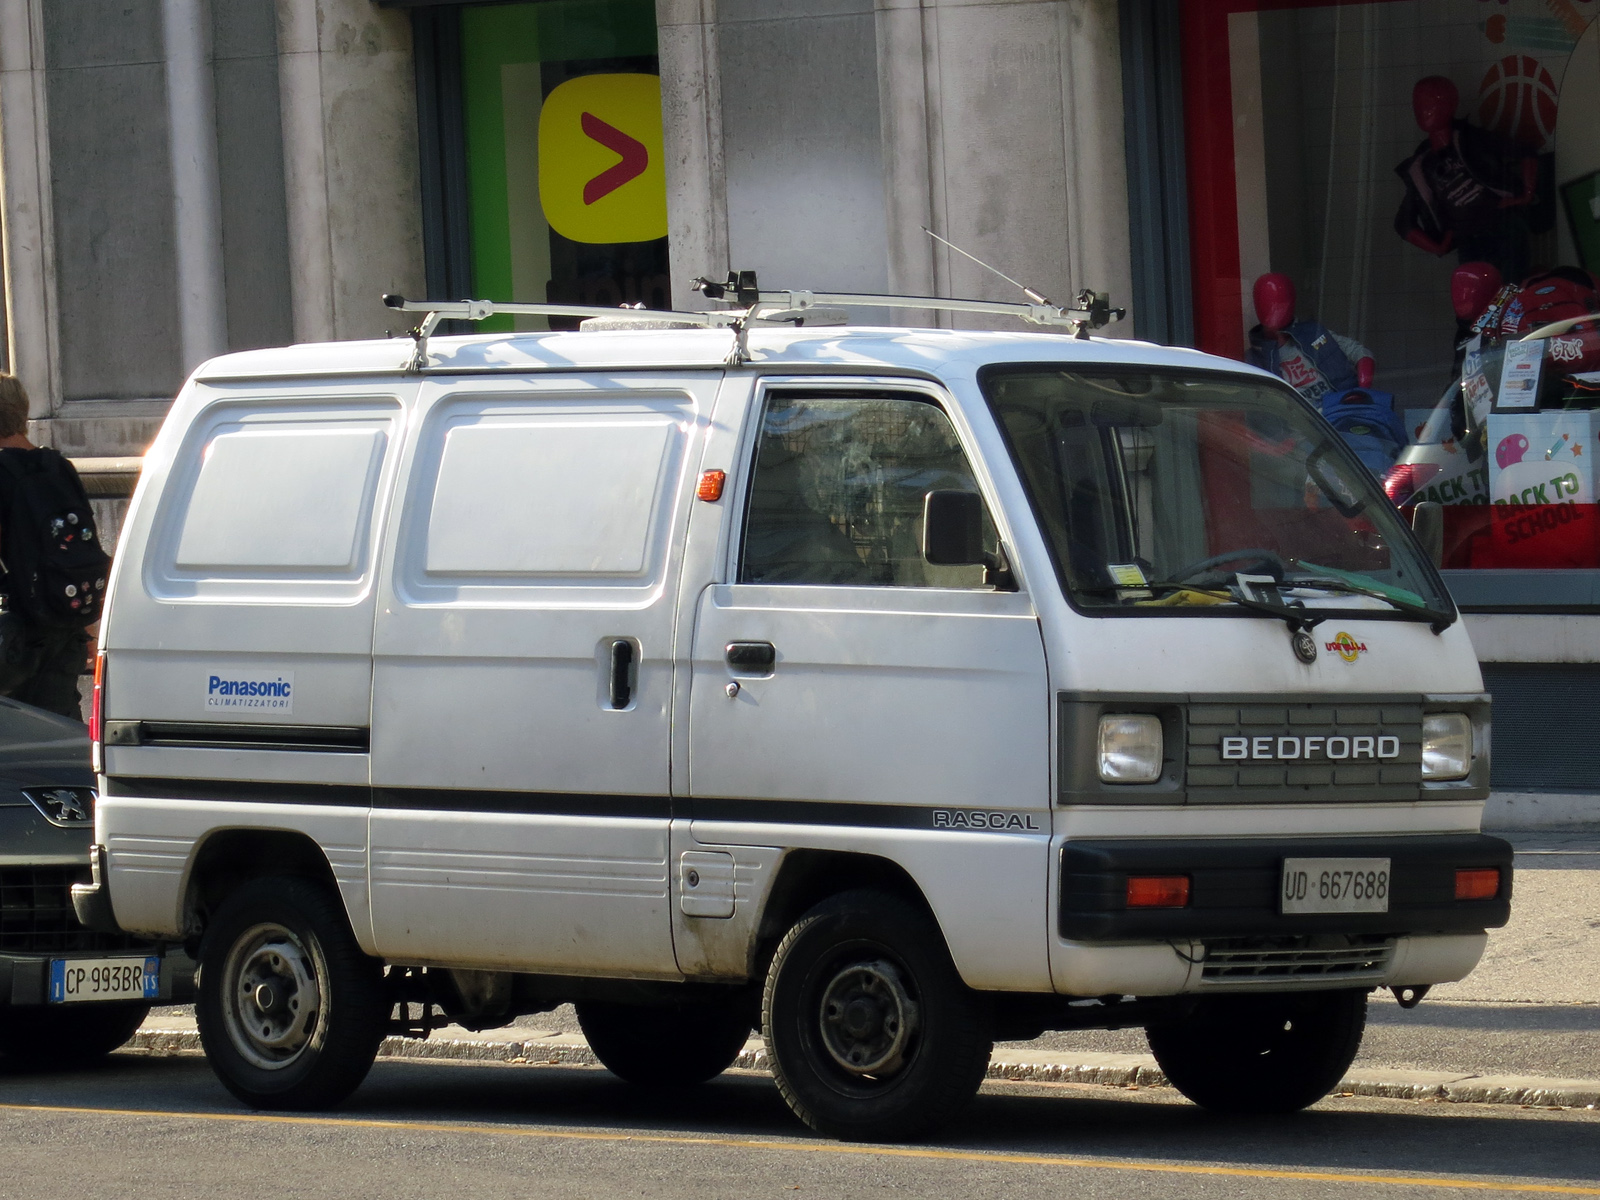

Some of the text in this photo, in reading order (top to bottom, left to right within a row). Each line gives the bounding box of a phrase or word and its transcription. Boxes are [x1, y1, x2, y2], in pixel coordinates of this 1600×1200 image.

[1494, 472, 1579, 520] BACK TO
[1504, 499, 1584, 544] SCHOOL
[208, 675, 291, 697] Panasonic
[208, 697, 289, 708] CLIMATIZZATORI
[1222, 735, 1400, 759] BEDFORD
[932, 809, 1040, 831] RASCAL
[1285, 870, 1387, 900] UD 667688
[66, 968, 86, 994] CP
[91, 965, 142, 992] 993BR
[143, 975, 157, 990] TS
